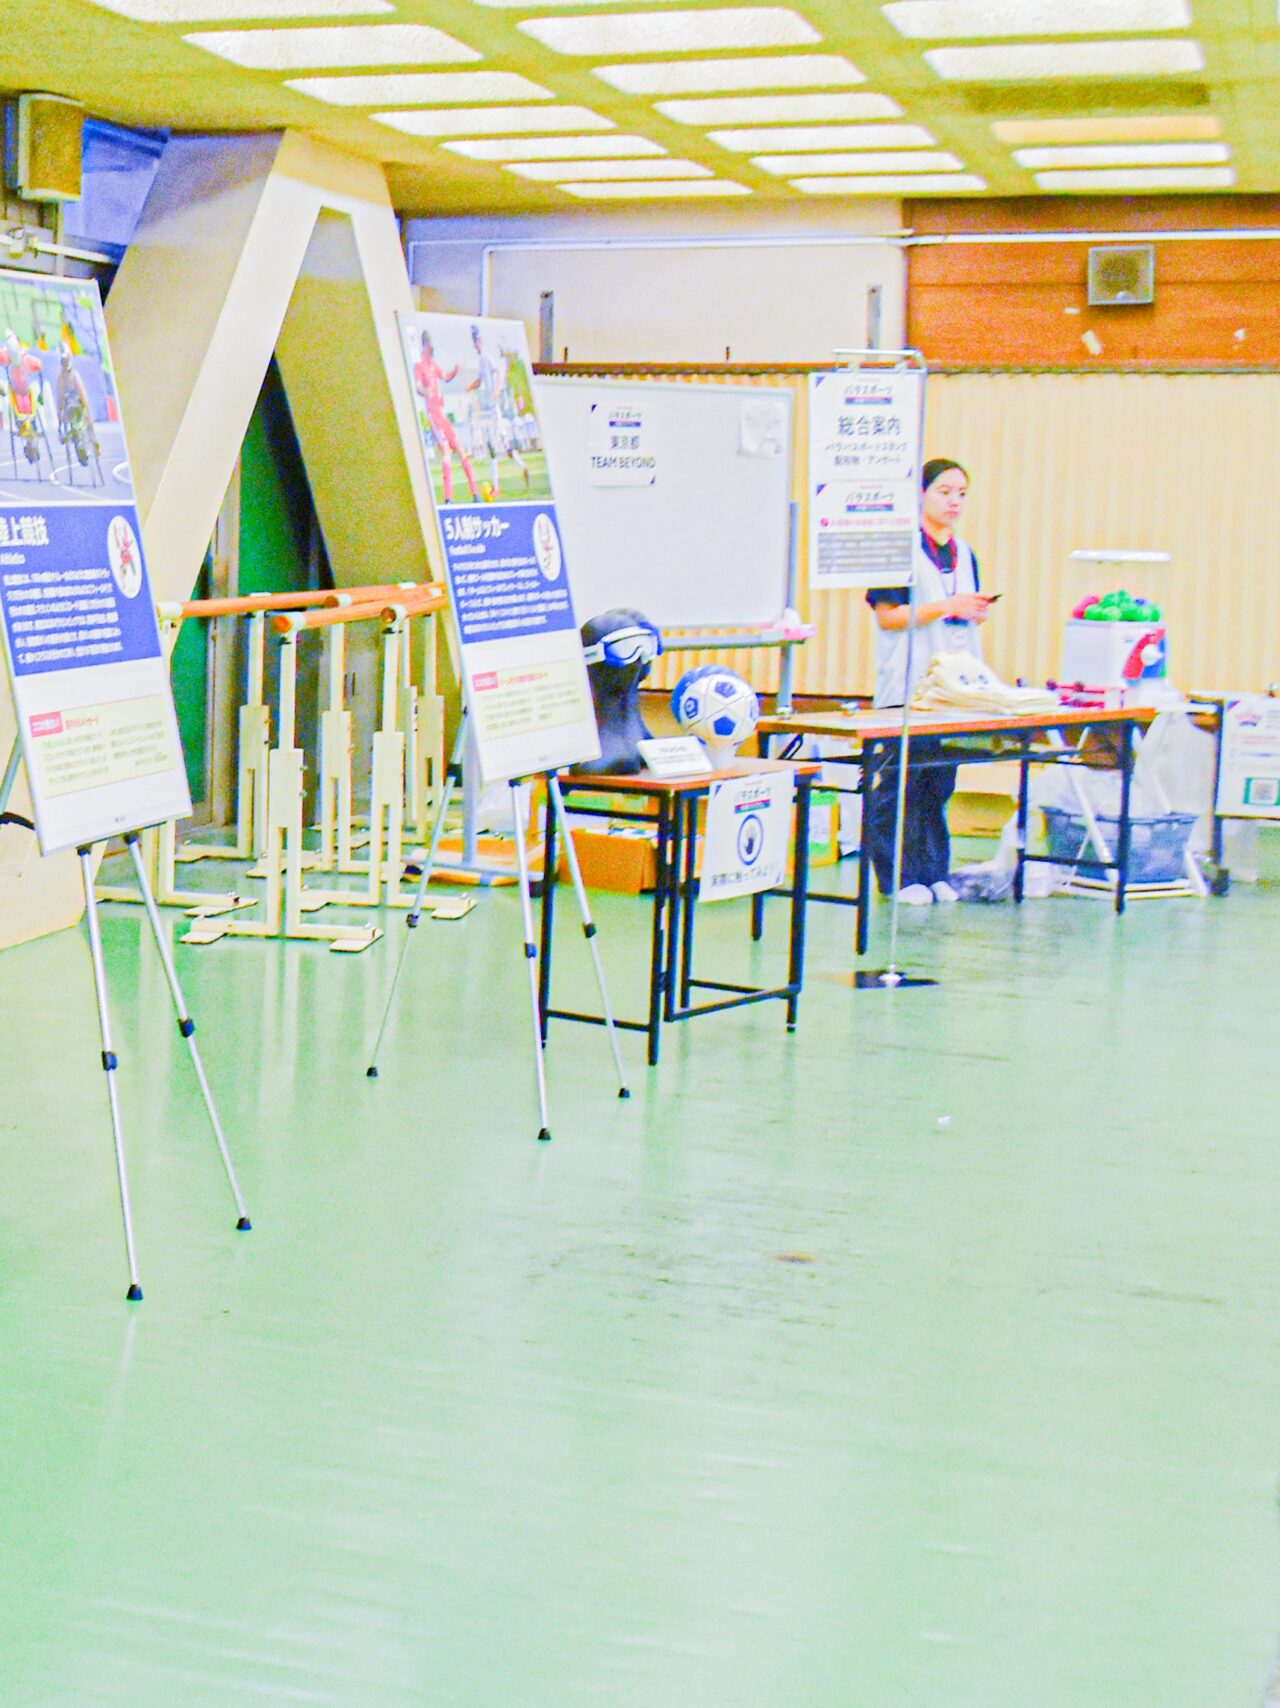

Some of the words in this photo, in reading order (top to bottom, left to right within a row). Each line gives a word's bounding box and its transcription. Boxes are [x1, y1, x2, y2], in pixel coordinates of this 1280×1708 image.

[837, 415, 901, 436] 総合案内
[610, 435, 640, 450] 東京都
[591, 456, 617, 468] TEAM
[619, 456, 656, 469] BEYOND
